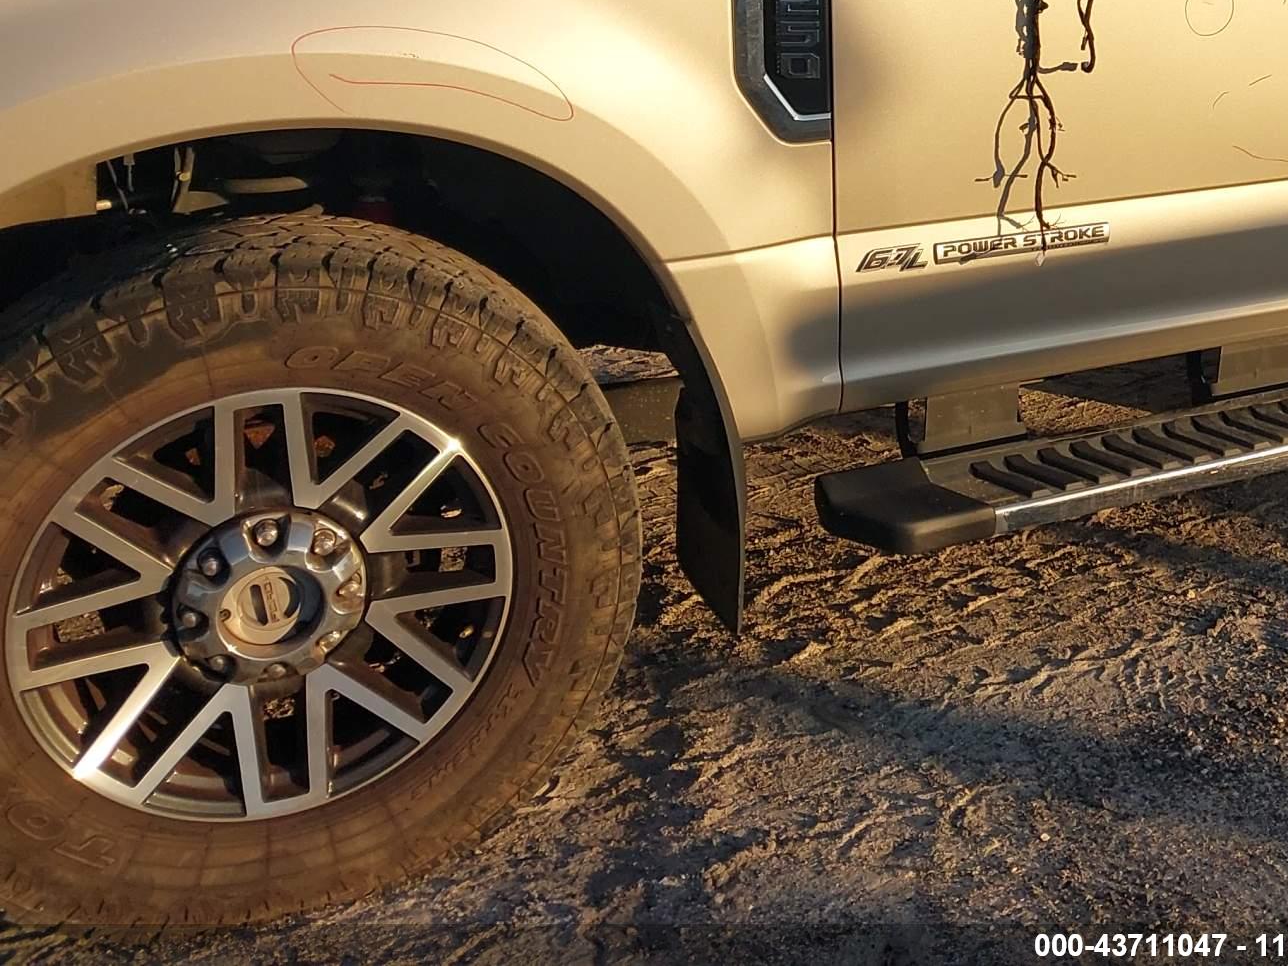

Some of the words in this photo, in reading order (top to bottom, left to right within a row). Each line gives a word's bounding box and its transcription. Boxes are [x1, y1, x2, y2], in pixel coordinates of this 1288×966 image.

[943, 236, 1017, 258] POWER
[285, 346, 479, 410] OPEN
[477, 422, 567, 688] COUNTRY
